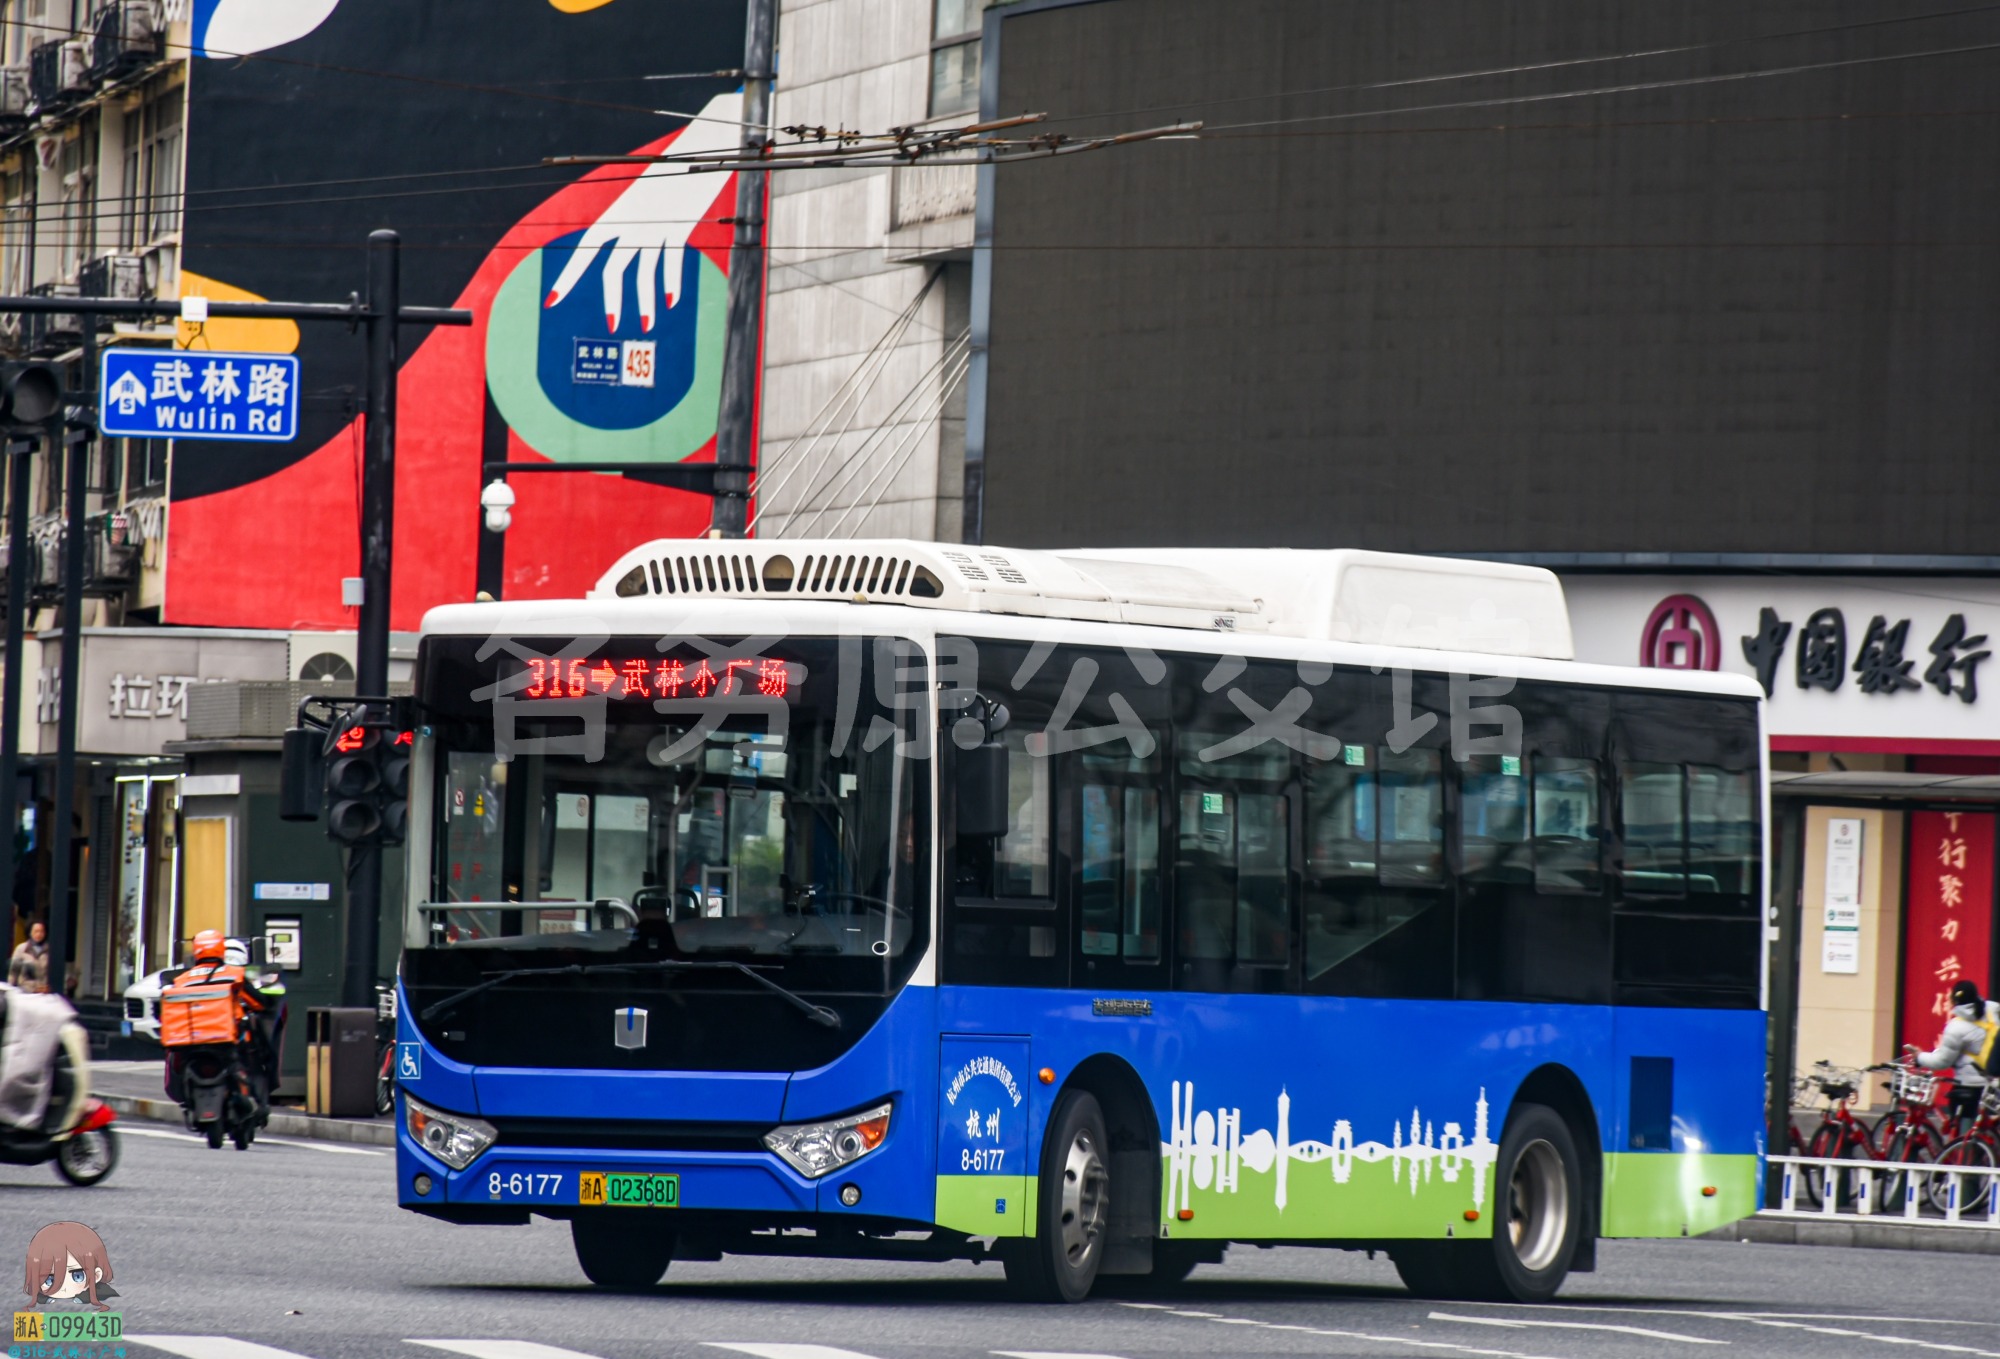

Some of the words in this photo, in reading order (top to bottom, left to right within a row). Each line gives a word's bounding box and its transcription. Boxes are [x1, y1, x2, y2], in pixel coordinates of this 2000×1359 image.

[626, 349, 652, 378] 435
[150, 359, 290, 406] 武林路
[122, 398, 132, 411] S
[155, 406, 236, 431] Wulin
[248, 409, 282, 433] Rd
[528, 659, 587, 697] 316
[621, 659, 788, 698] 武林小广场
[110, 673, 229, 719] 拉环
[966, 1107, 1001, 1144] 杭州
[961, 1148, 1005, 1171] 8-6177
[488, 1172, 563, 1196] 8-6177
